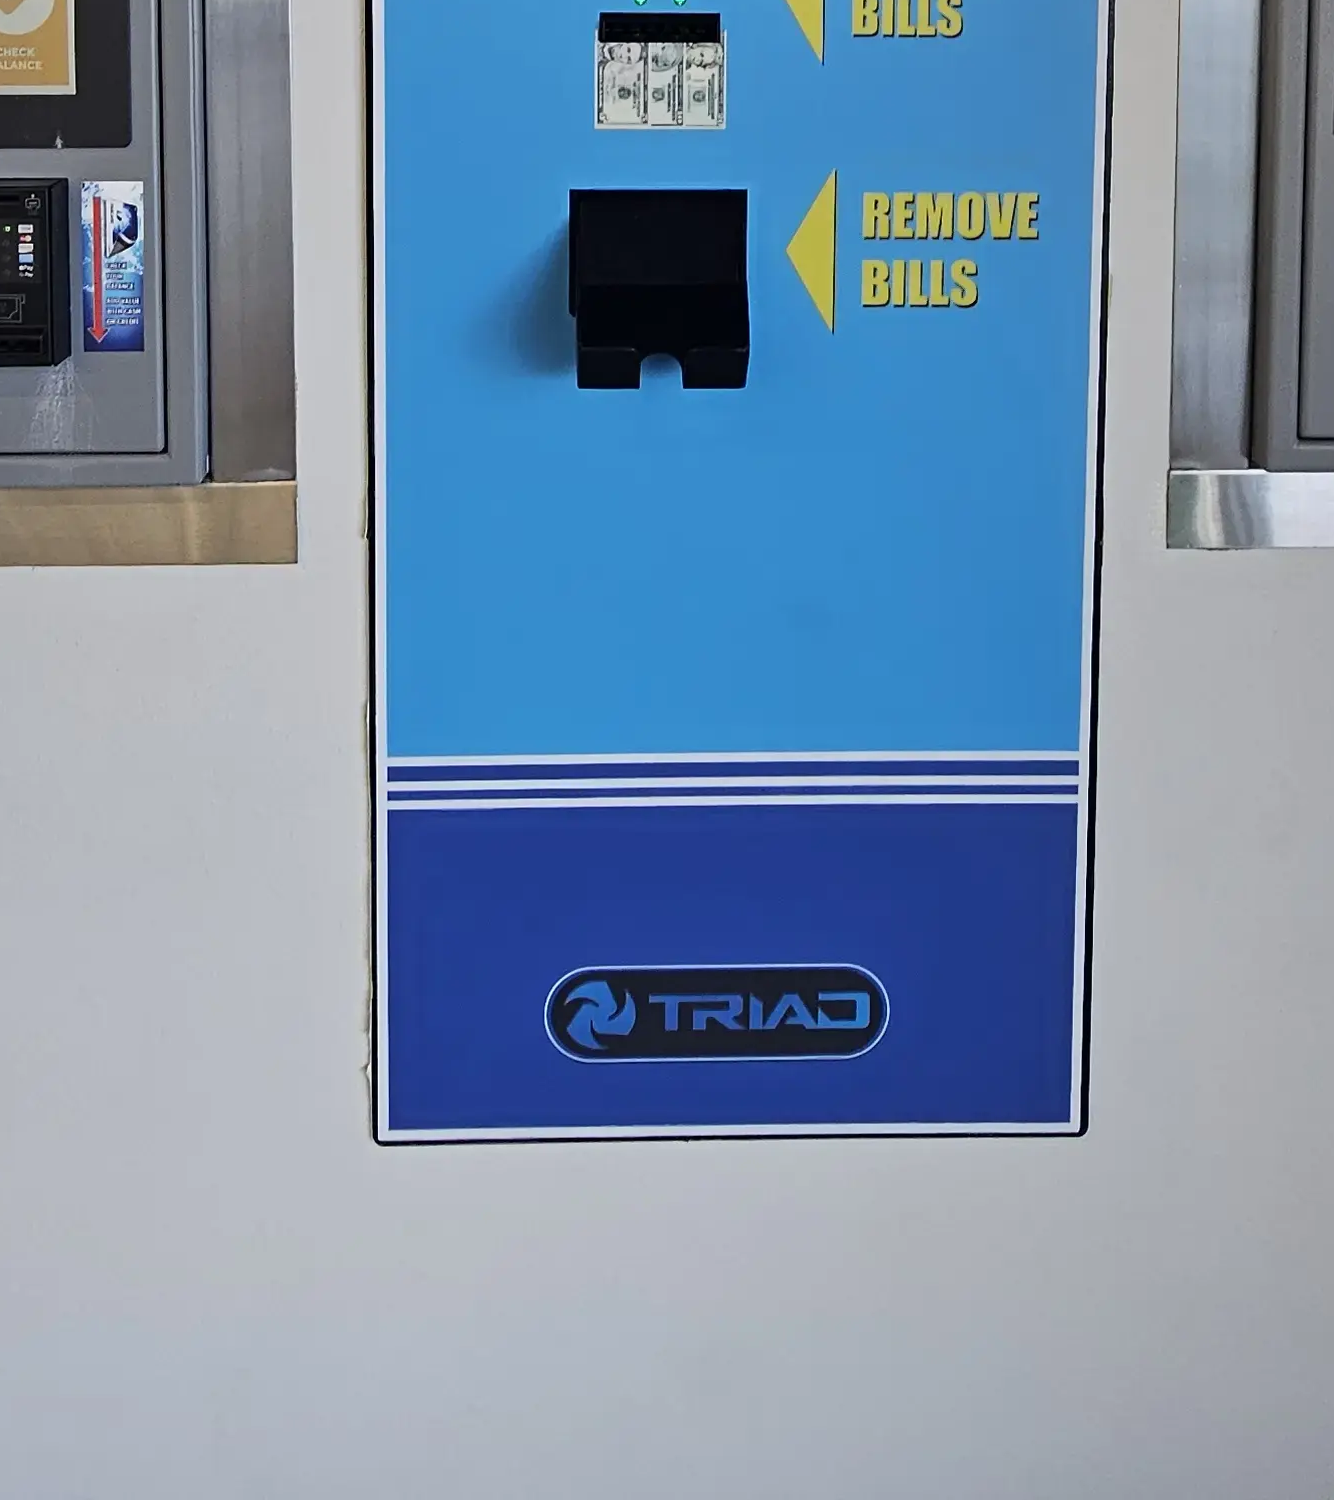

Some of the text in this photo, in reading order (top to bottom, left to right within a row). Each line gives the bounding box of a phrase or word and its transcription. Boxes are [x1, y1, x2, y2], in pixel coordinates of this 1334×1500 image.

[862, 191, 1037, 238] REMOVE
[861, 258, 977, 306] BILLS
[648, 991, 870, 1031] TRIAD
